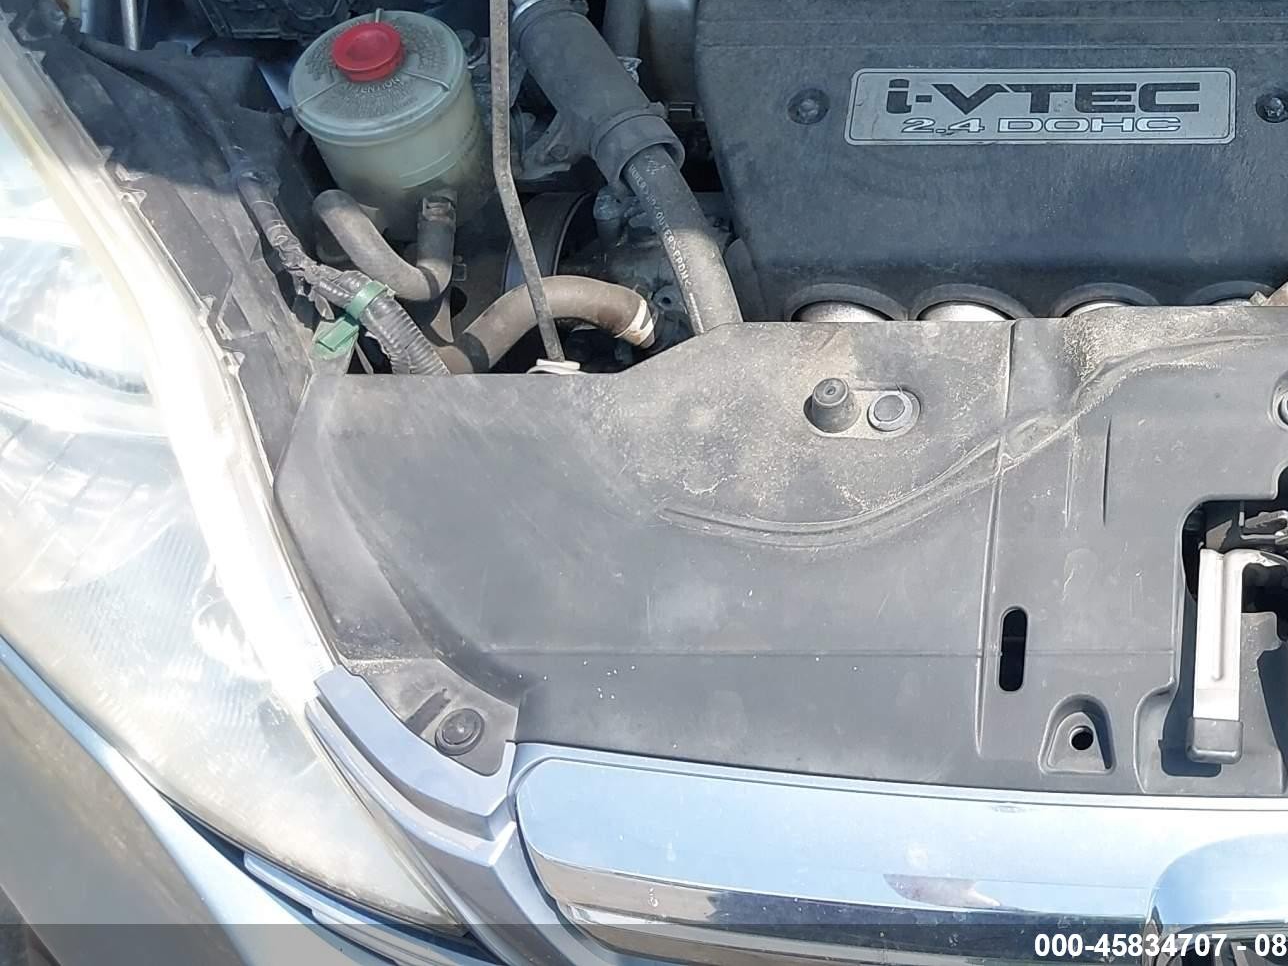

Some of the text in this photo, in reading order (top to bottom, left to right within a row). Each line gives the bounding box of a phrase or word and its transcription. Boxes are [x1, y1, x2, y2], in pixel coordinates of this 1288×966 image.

[886, 79, 1200, 116] i-VTEC
[901, 117, 1181, 134] 2.4 DOHC
